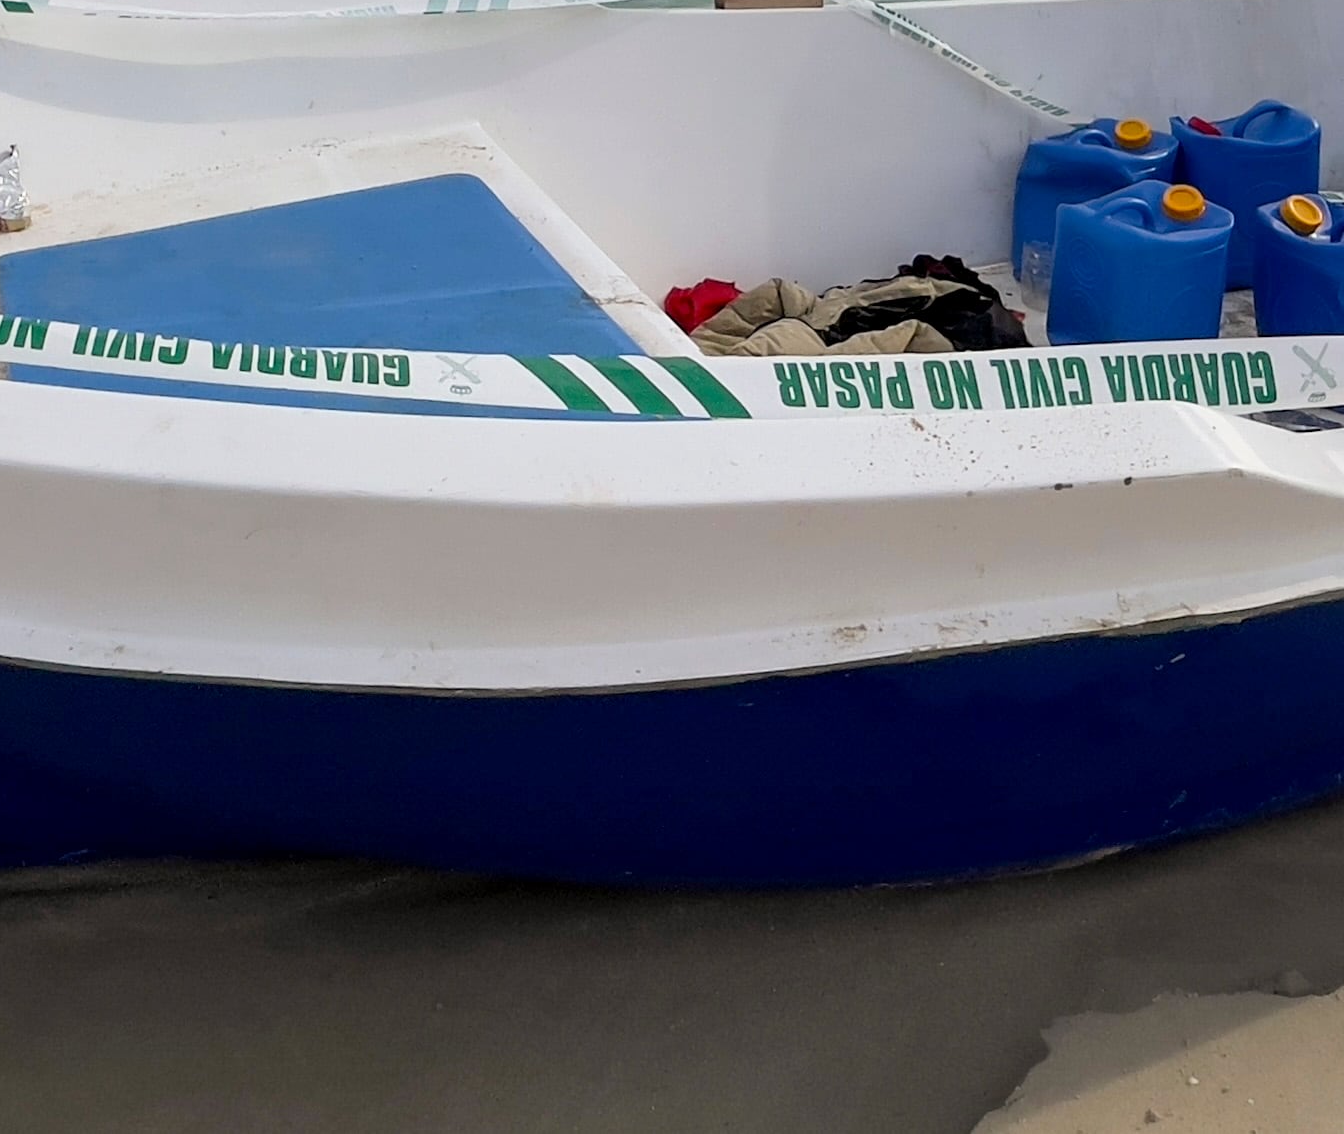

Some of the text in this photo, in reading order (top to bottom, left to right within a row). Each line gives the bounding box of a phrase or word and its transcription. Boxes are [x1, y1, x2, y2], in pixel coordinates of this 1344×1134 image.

[72, 324, 190, 365] CIVIL
[211, 343, 411, 387] GUARDIA
[773, 350, 1278, 410] GUARDIA CIVIL NO PASAR
